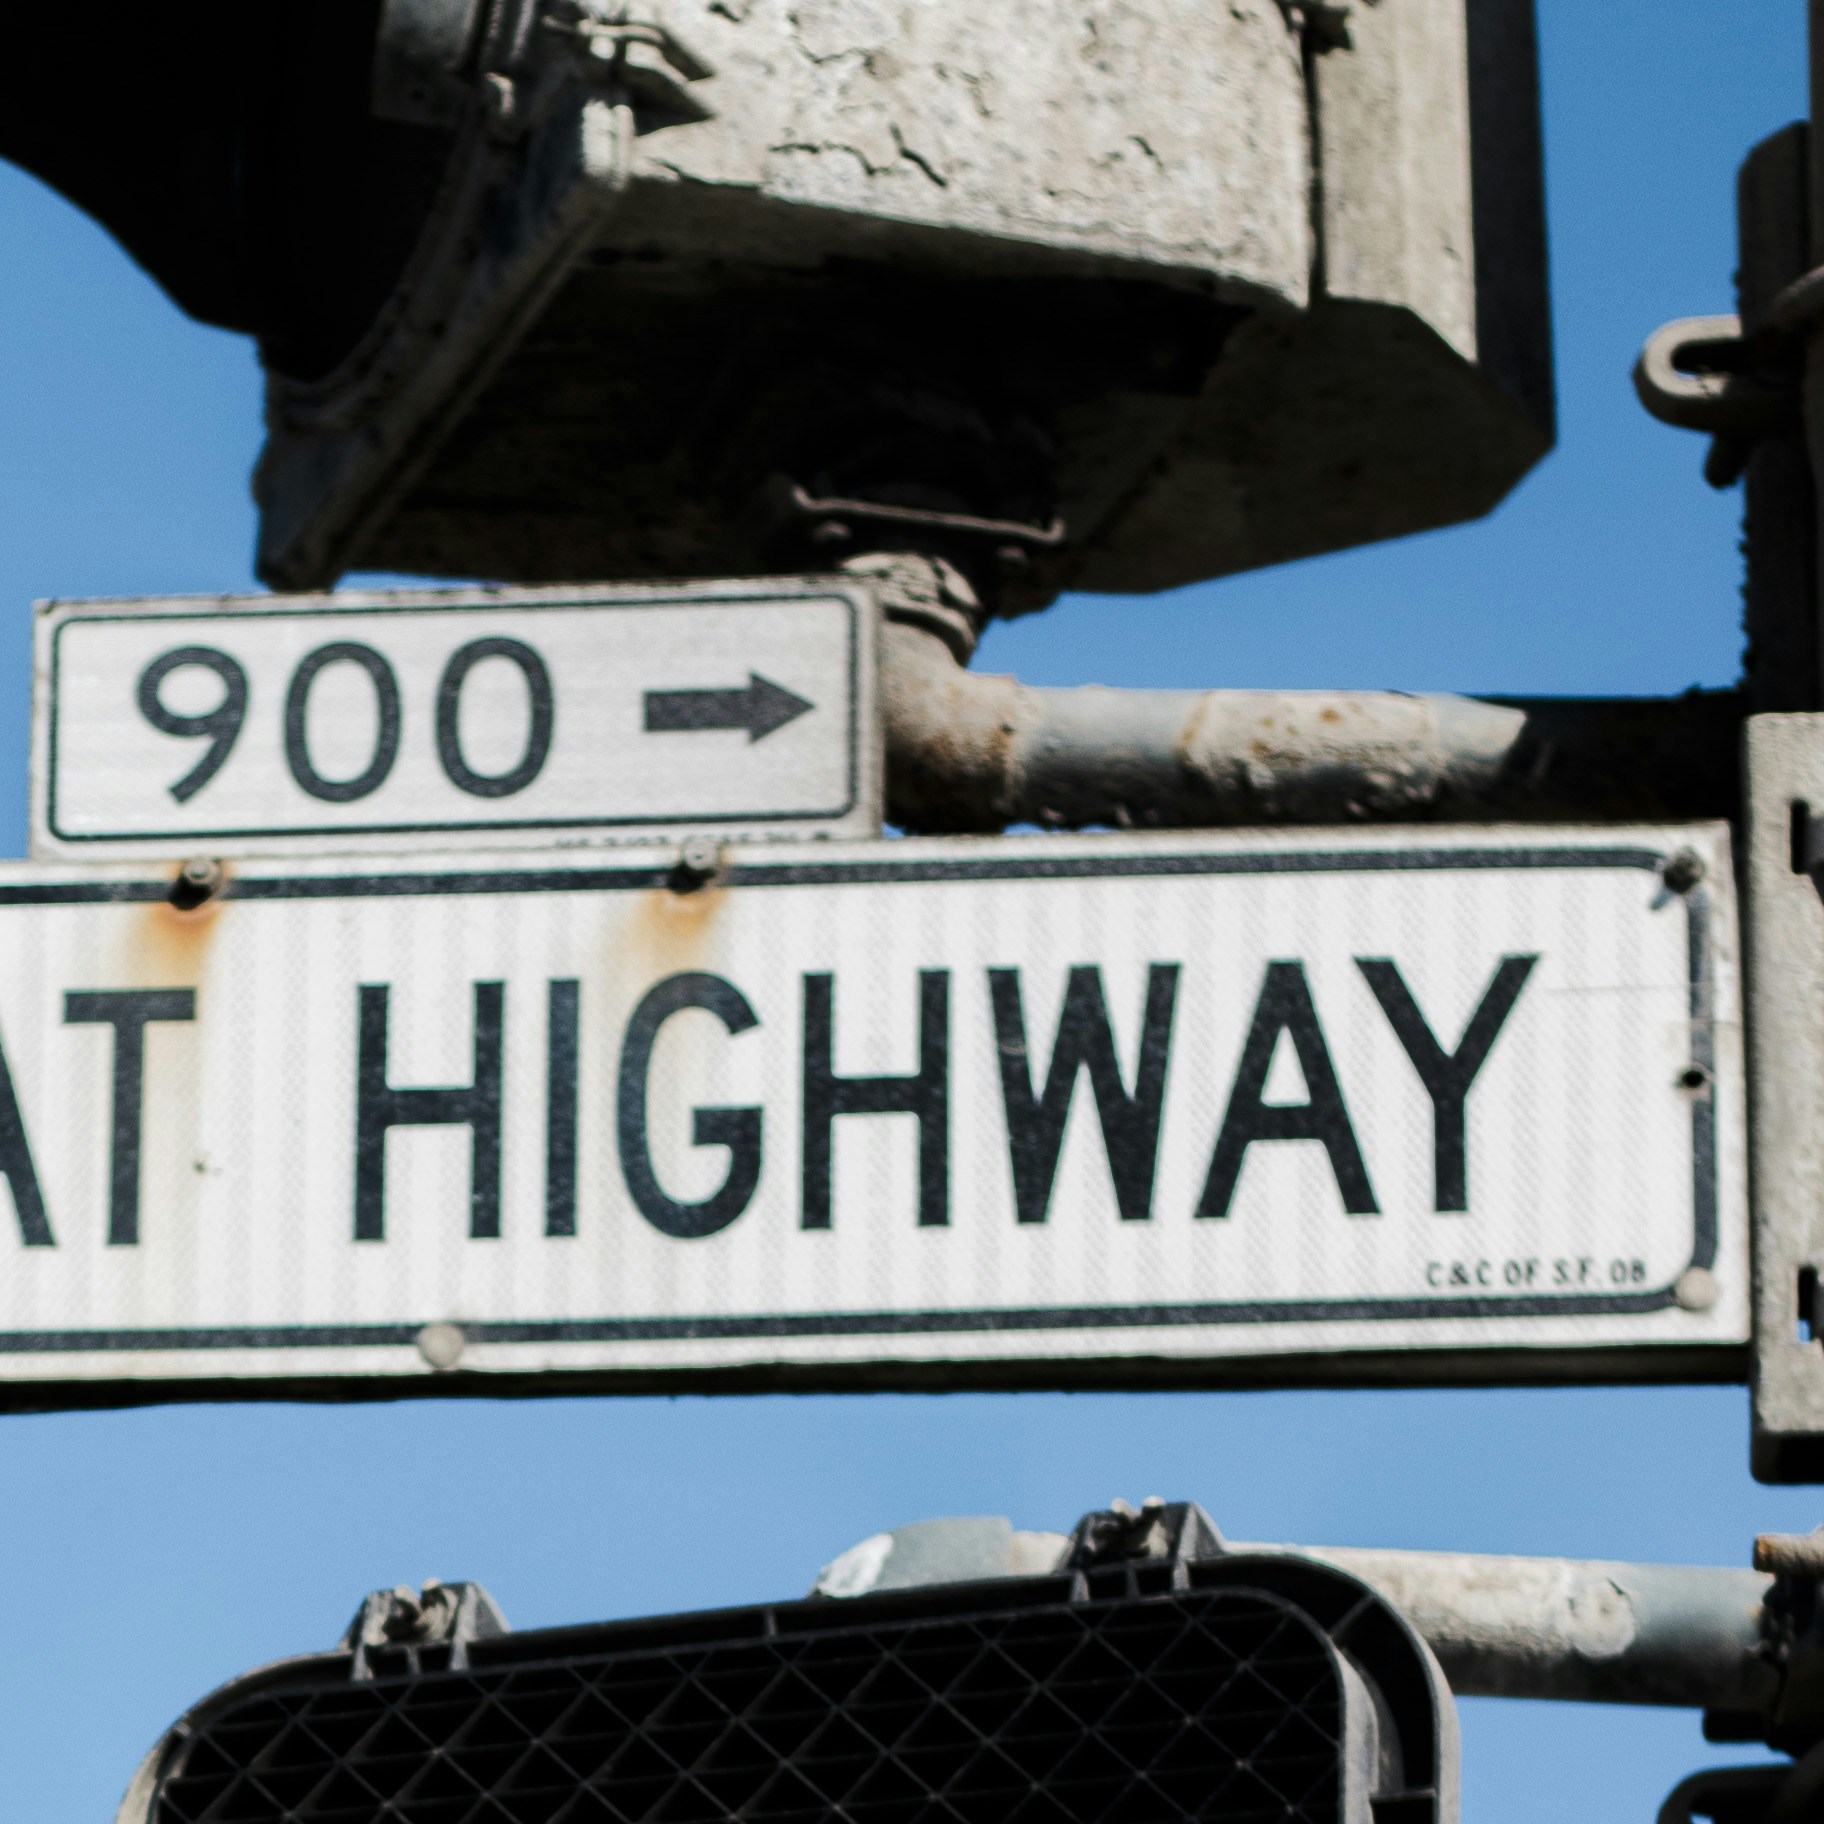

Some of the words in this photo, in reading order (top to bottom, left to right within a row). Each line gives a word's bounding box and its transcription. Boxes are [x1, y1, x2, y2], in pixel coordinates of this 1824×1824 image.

[136, 636, 555, 804] 900
[352, 953, 1541, 1241] HIGHWAY
[1503, 1256, 1541, 1286] OF
